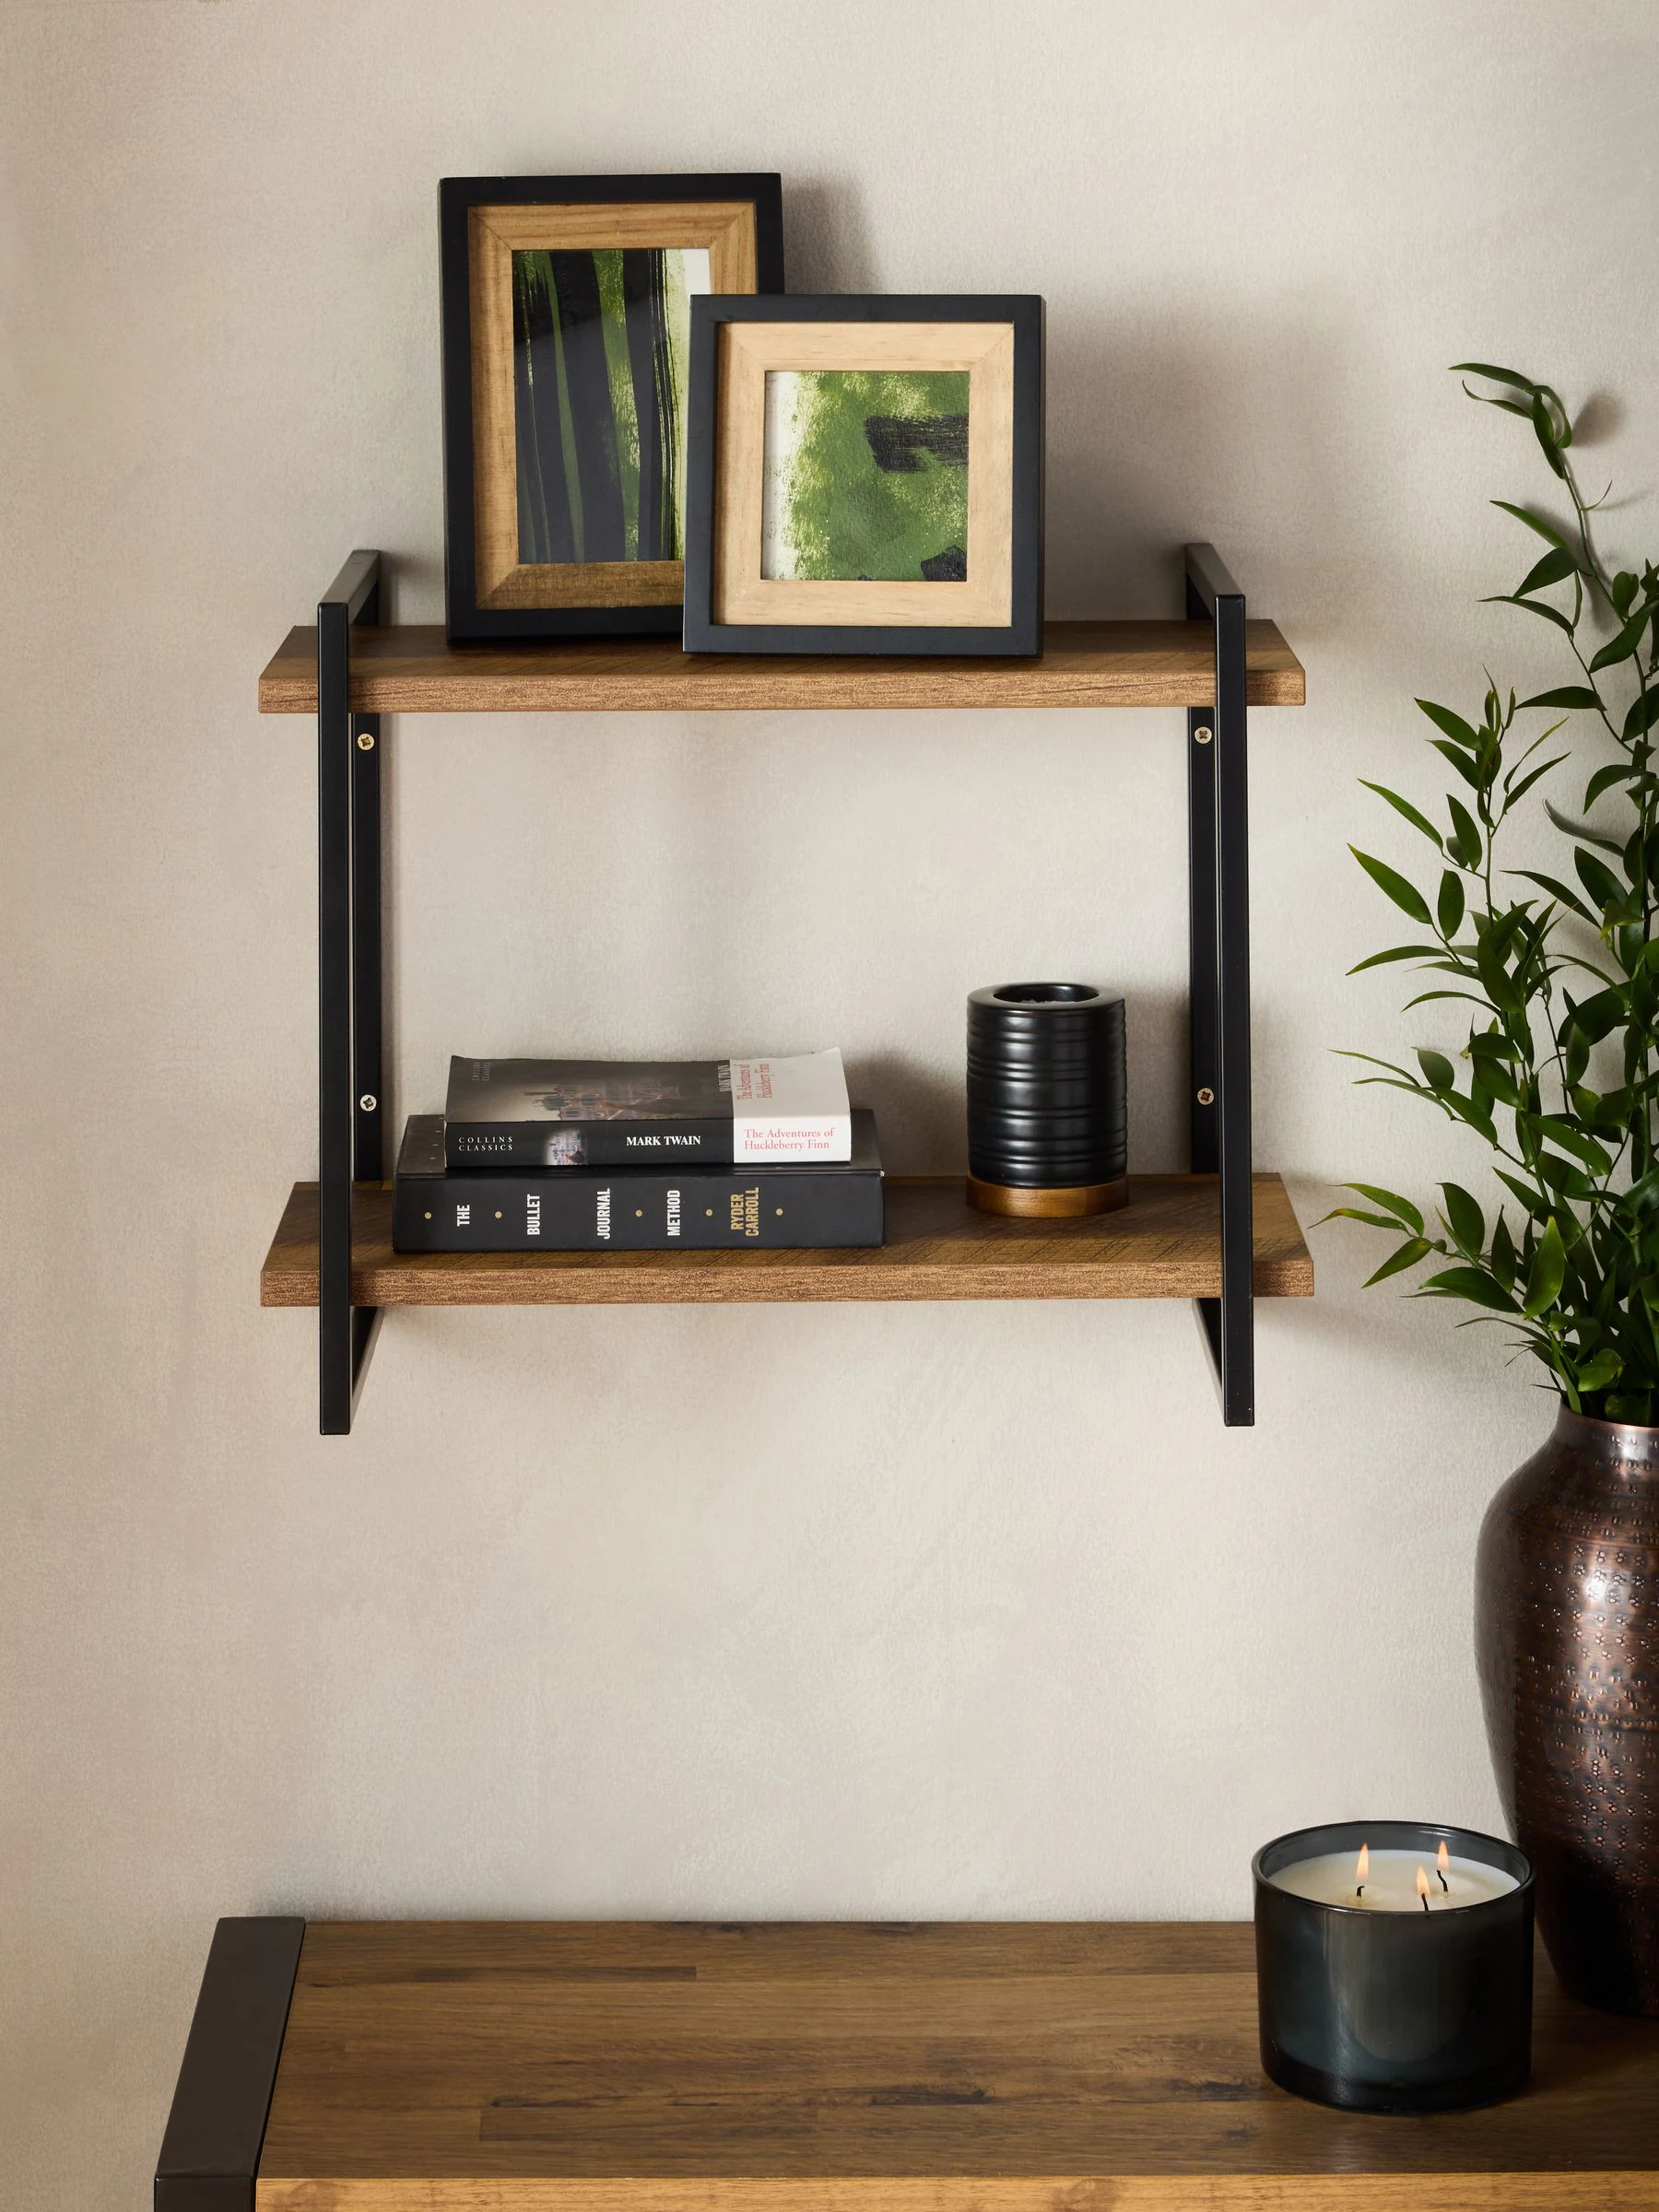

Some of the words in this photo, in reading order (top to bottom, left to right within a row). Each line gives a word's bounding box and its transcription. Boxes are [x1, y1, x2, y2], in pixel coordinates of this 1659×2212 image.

[458, 1135, 513, 1145] COLLINS
[626, 1135, 662, 1147] MARK
[664, 1135, 701, 1146] TWAIN
[744, 1128, 764, 1138] The
[767, 1127, 821, 1138] Adventures
[823, 1127, 836, 1137] of
[458, 1144, 513, 1152] CLASSICS
[744, 1139, 805, 1152] Huckleberry
[807, 1139, 830, 1149] Finn
[456, 1204, 471, 1228] THE
[526, 1194, 541, 1236] BULLET
[596, 1187, 611, 1240] JOURNAL
[666, 1189, 681, 1237] METHOD
[730, 1194, 745, 1230] RYDER
[745, 1186, 759, 1237] CARROLL
